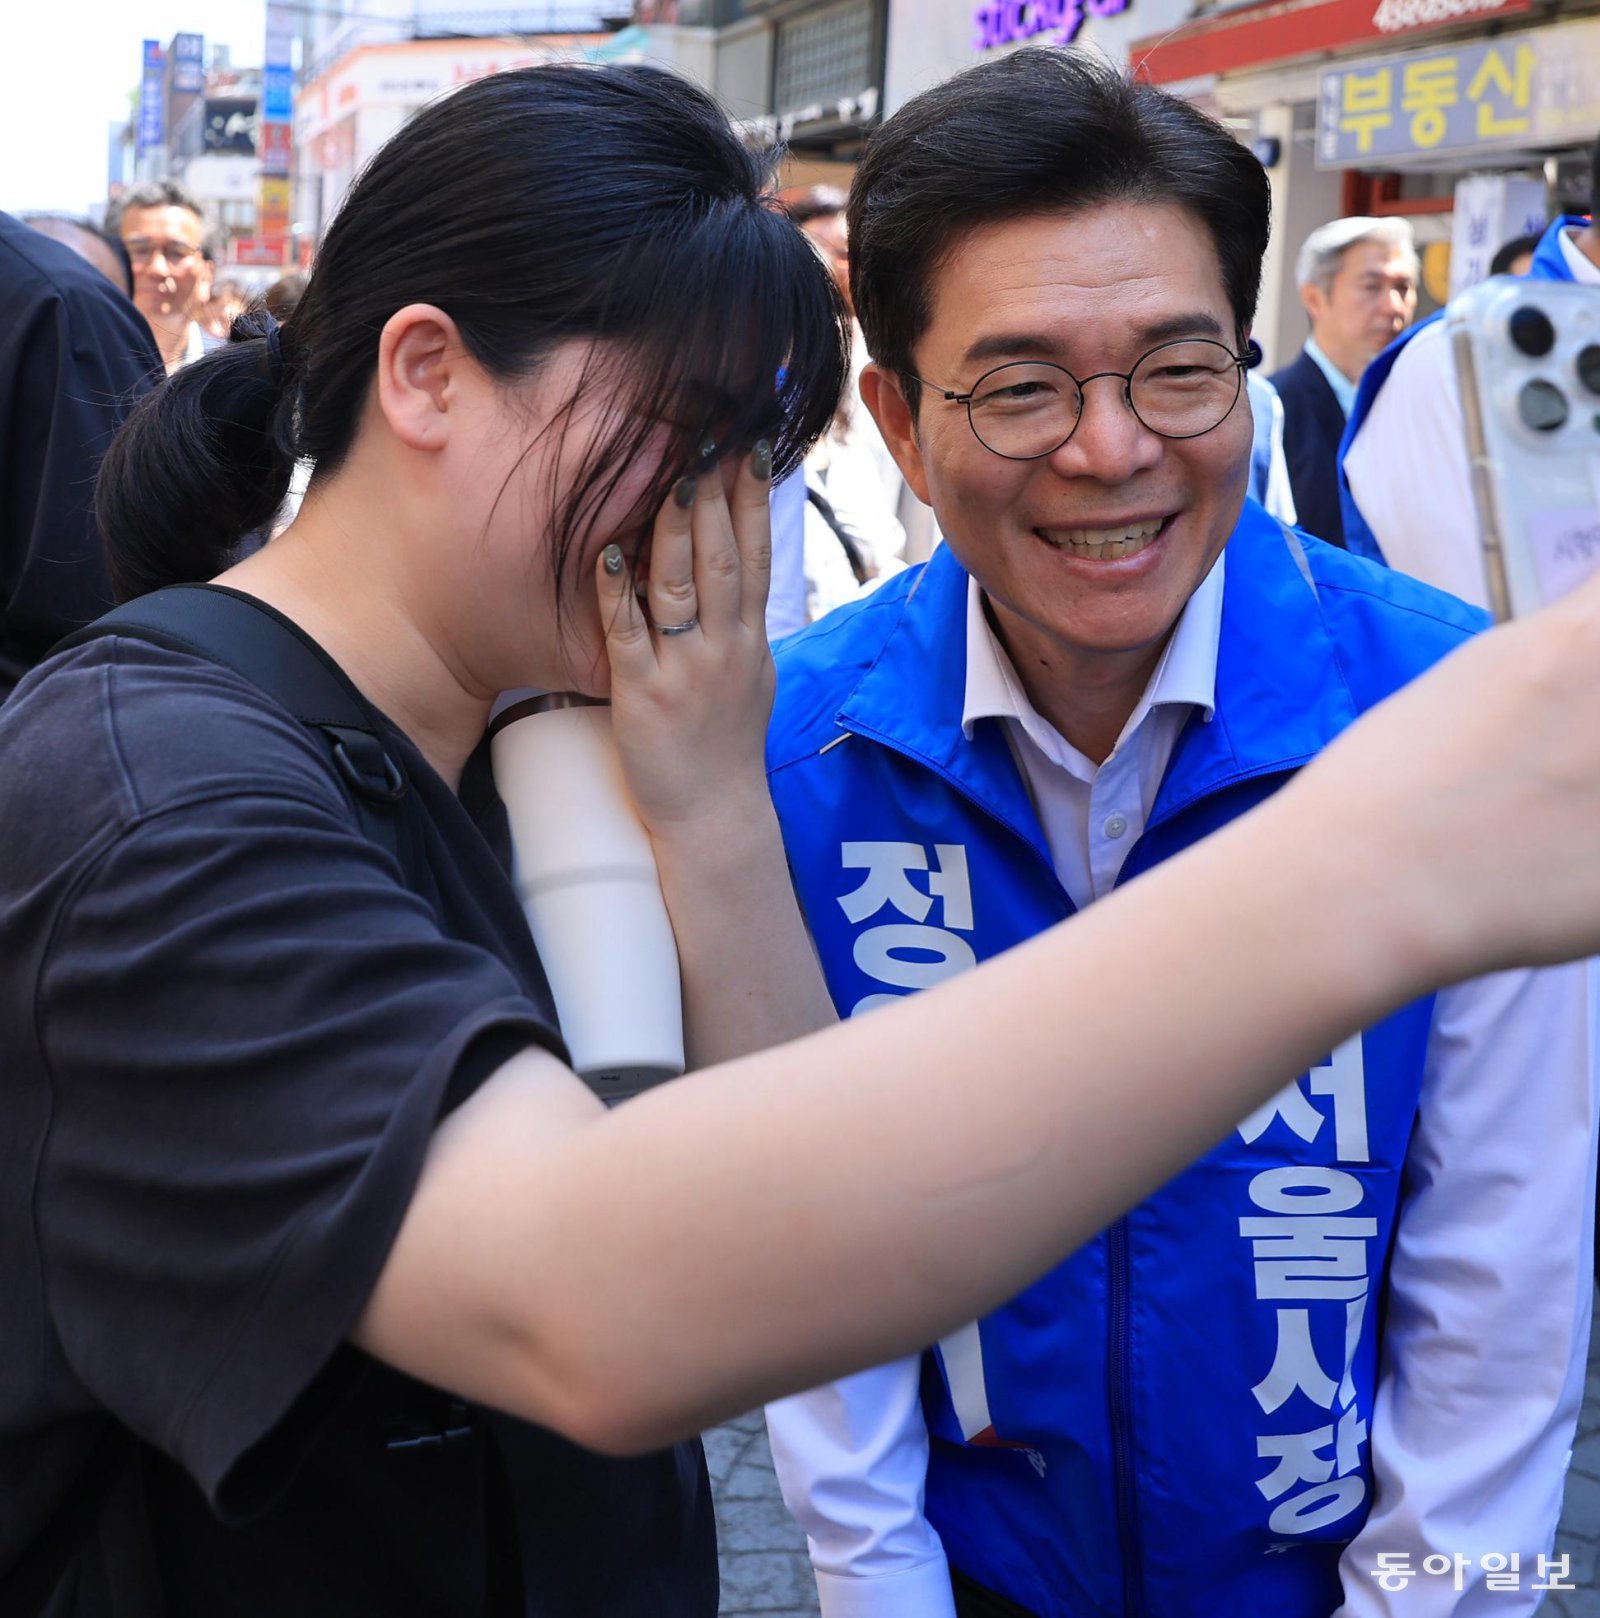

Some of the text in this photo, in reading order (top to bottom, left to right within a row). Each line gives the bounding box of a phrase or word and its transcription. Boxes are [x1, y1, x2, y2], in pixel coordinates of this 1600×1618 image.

[1340, 43, 1537, 153] 부동산
[836, 841, 977, 1018] 정
[1236, 1030, 1378, 1535] 서울시장
